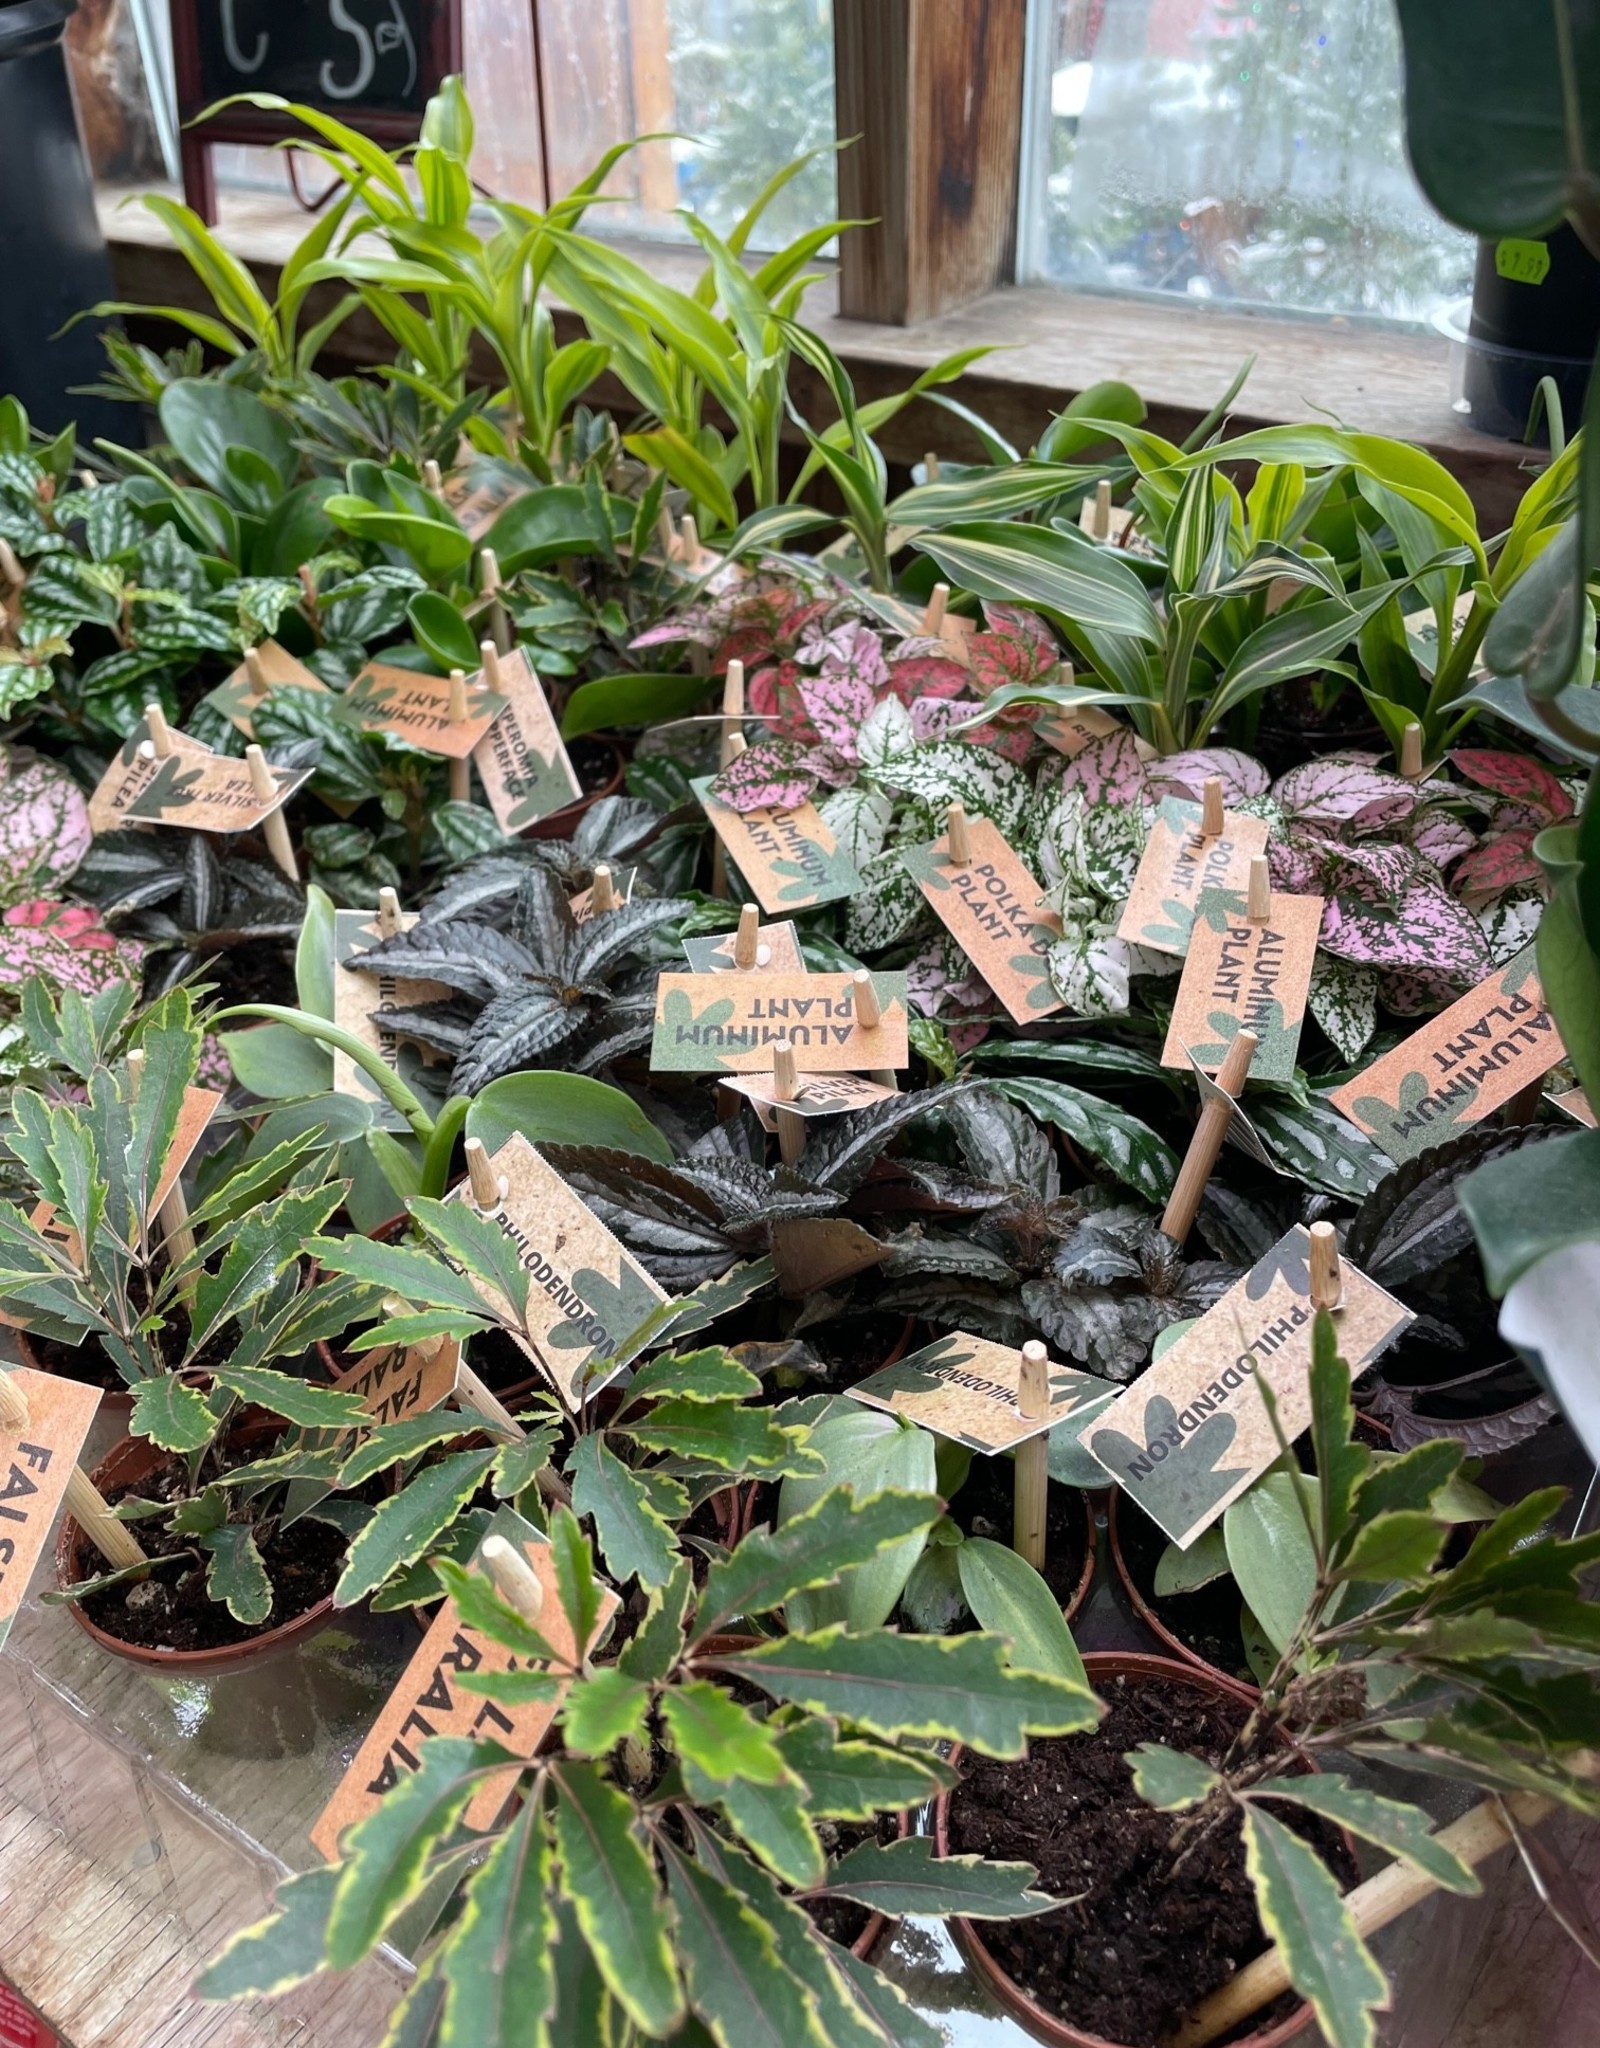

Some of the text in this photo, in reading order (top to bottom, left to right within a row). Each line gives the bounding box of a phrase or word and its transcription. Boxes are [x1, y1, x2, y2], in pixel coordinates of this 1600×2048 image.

[347, 699, 450, 731] ALUMINUM
[110, 758, 148, 809] PILEA
[766, 806, 833, 887] LUMINUM
[1170, 831, 1207, 891] PLANT
[951, 873, 1013, 941] PLANT
[974, 863, 1035, 938] POLKA
[1211, 927, 1252, 1004] PLANT
[675, 1024, 854, 1046] ALUMINUM
[747, 998, 853, 1019] PLANT
[1432, 992, 1533, 1073] PLANT
[810, 1086, 876, 1100] PILEA
[1391, 1011, 1552, 1140] ALUMINUM
[1127, 1304, 1310, 1482] PHILODENDRON
